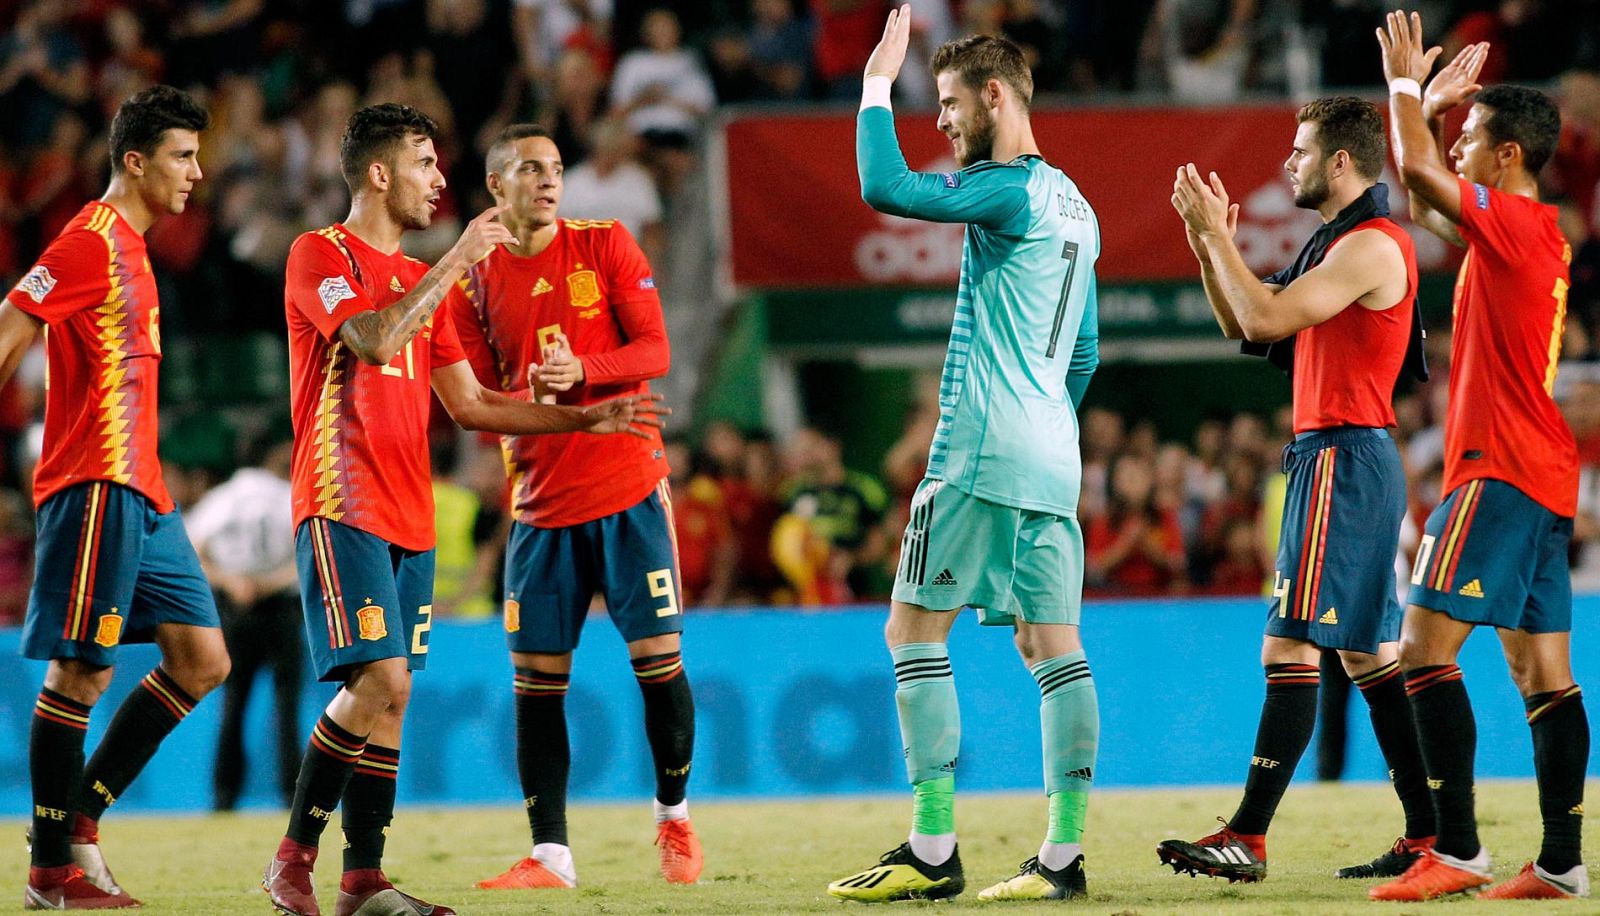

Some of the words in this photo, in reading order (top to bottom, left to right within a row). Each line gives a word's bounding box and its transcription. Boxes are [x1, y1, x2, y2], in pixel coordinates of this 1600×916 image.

[646, 568, 679, 618] 9
[1273, 570, 1291, 619] 4
[411, 604, 433, 654] 2
